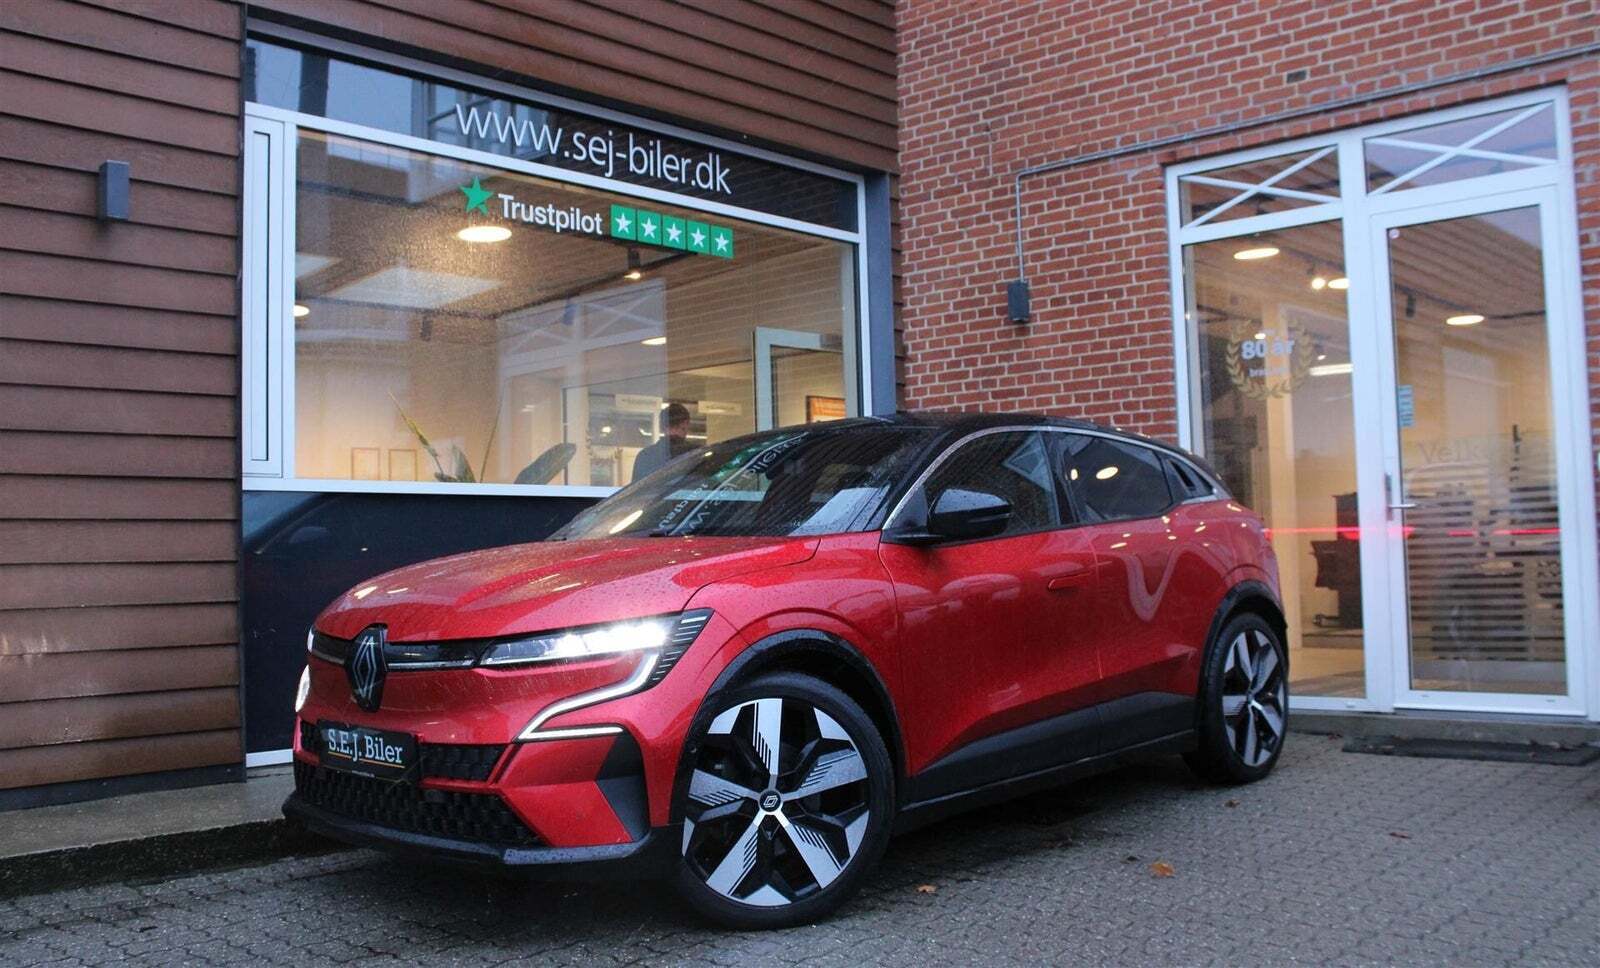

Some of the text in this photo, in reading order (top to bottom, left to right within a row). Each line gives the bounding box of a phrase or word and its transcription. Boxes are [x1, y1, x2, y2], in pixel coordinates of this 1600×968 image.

[456, 104, 732, 194] www.sej-biler.dk
[498, 193, 603, 234] Trustpilot
[1241, 340, 1267, 360] 80
[328, 729, 403, 763] S.E.J. Biler
